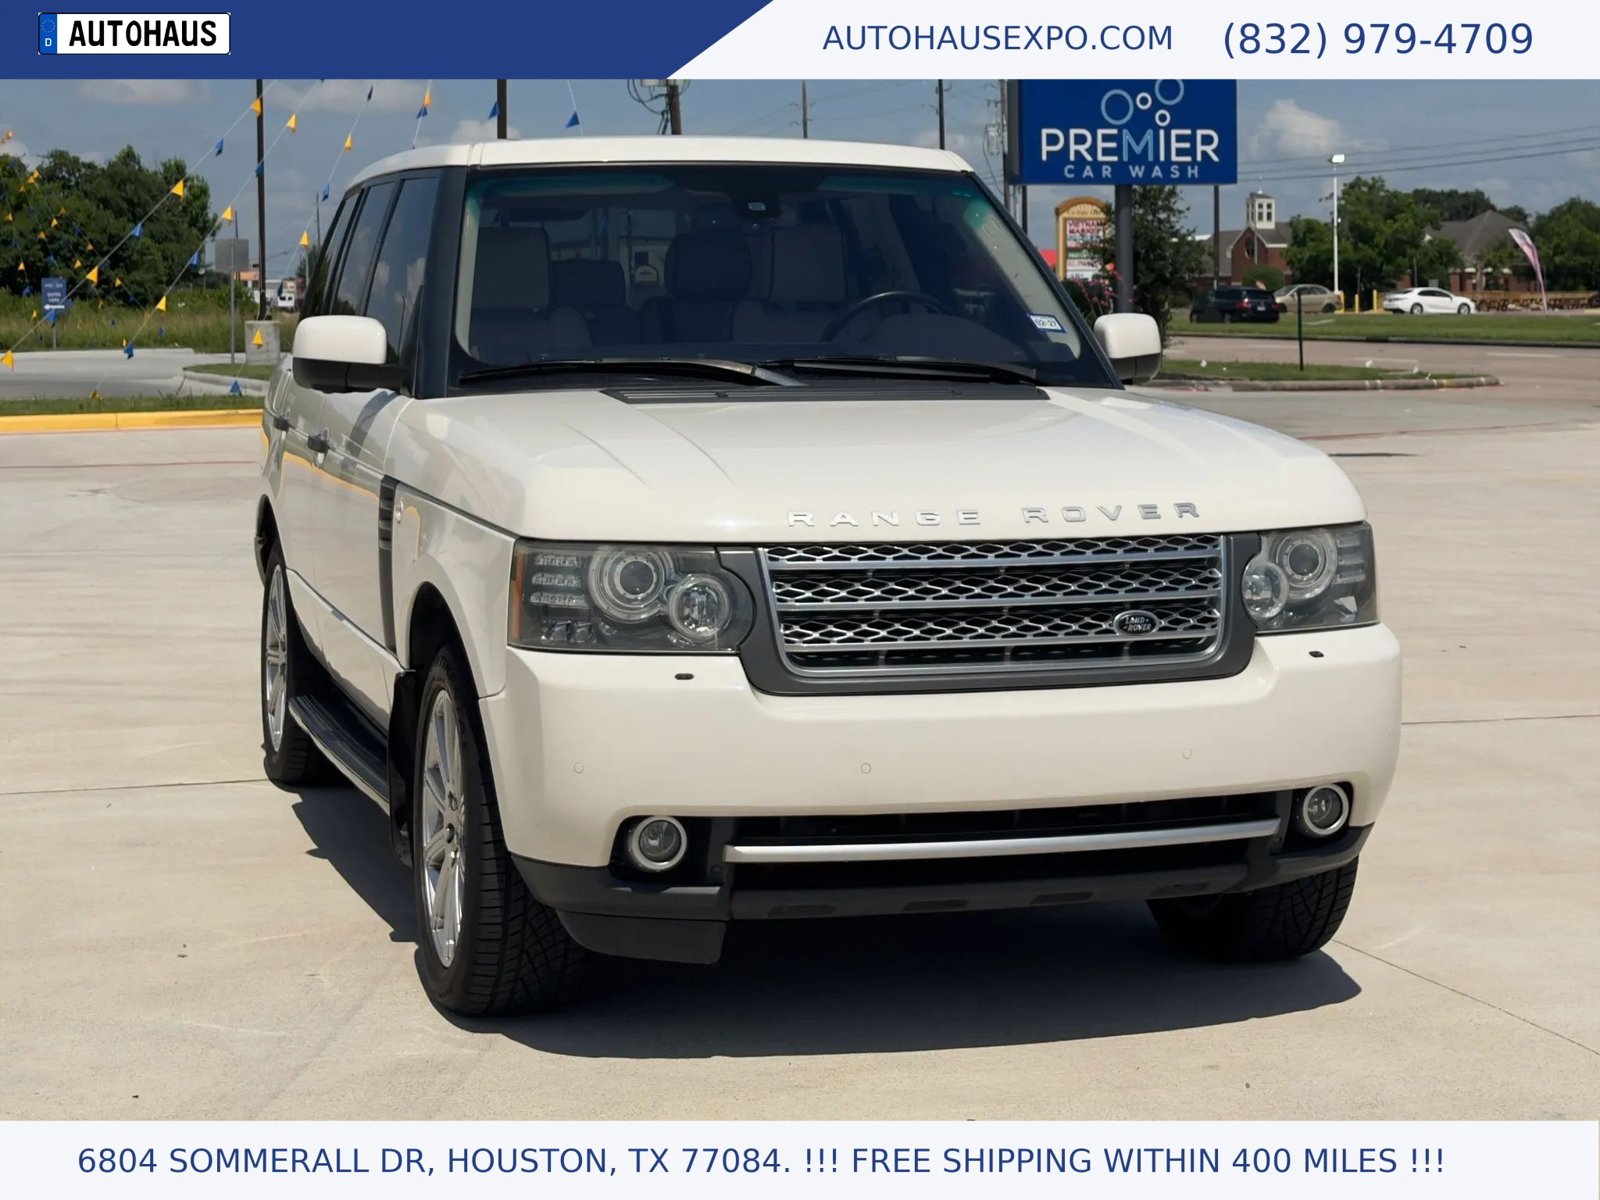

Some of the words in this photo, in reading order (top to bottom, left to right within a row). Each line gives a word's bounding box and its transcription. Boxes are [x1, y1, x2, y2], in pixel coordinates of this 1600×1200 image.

[1041, 128, 1220, 162] PREMIER
[1064, 165, 1112, 179] CAR
[1129, 165, 1199, 179] WASH
[787, 509, 981, 527] RANGE
[1021, 502, 1200, 523] ROVER
